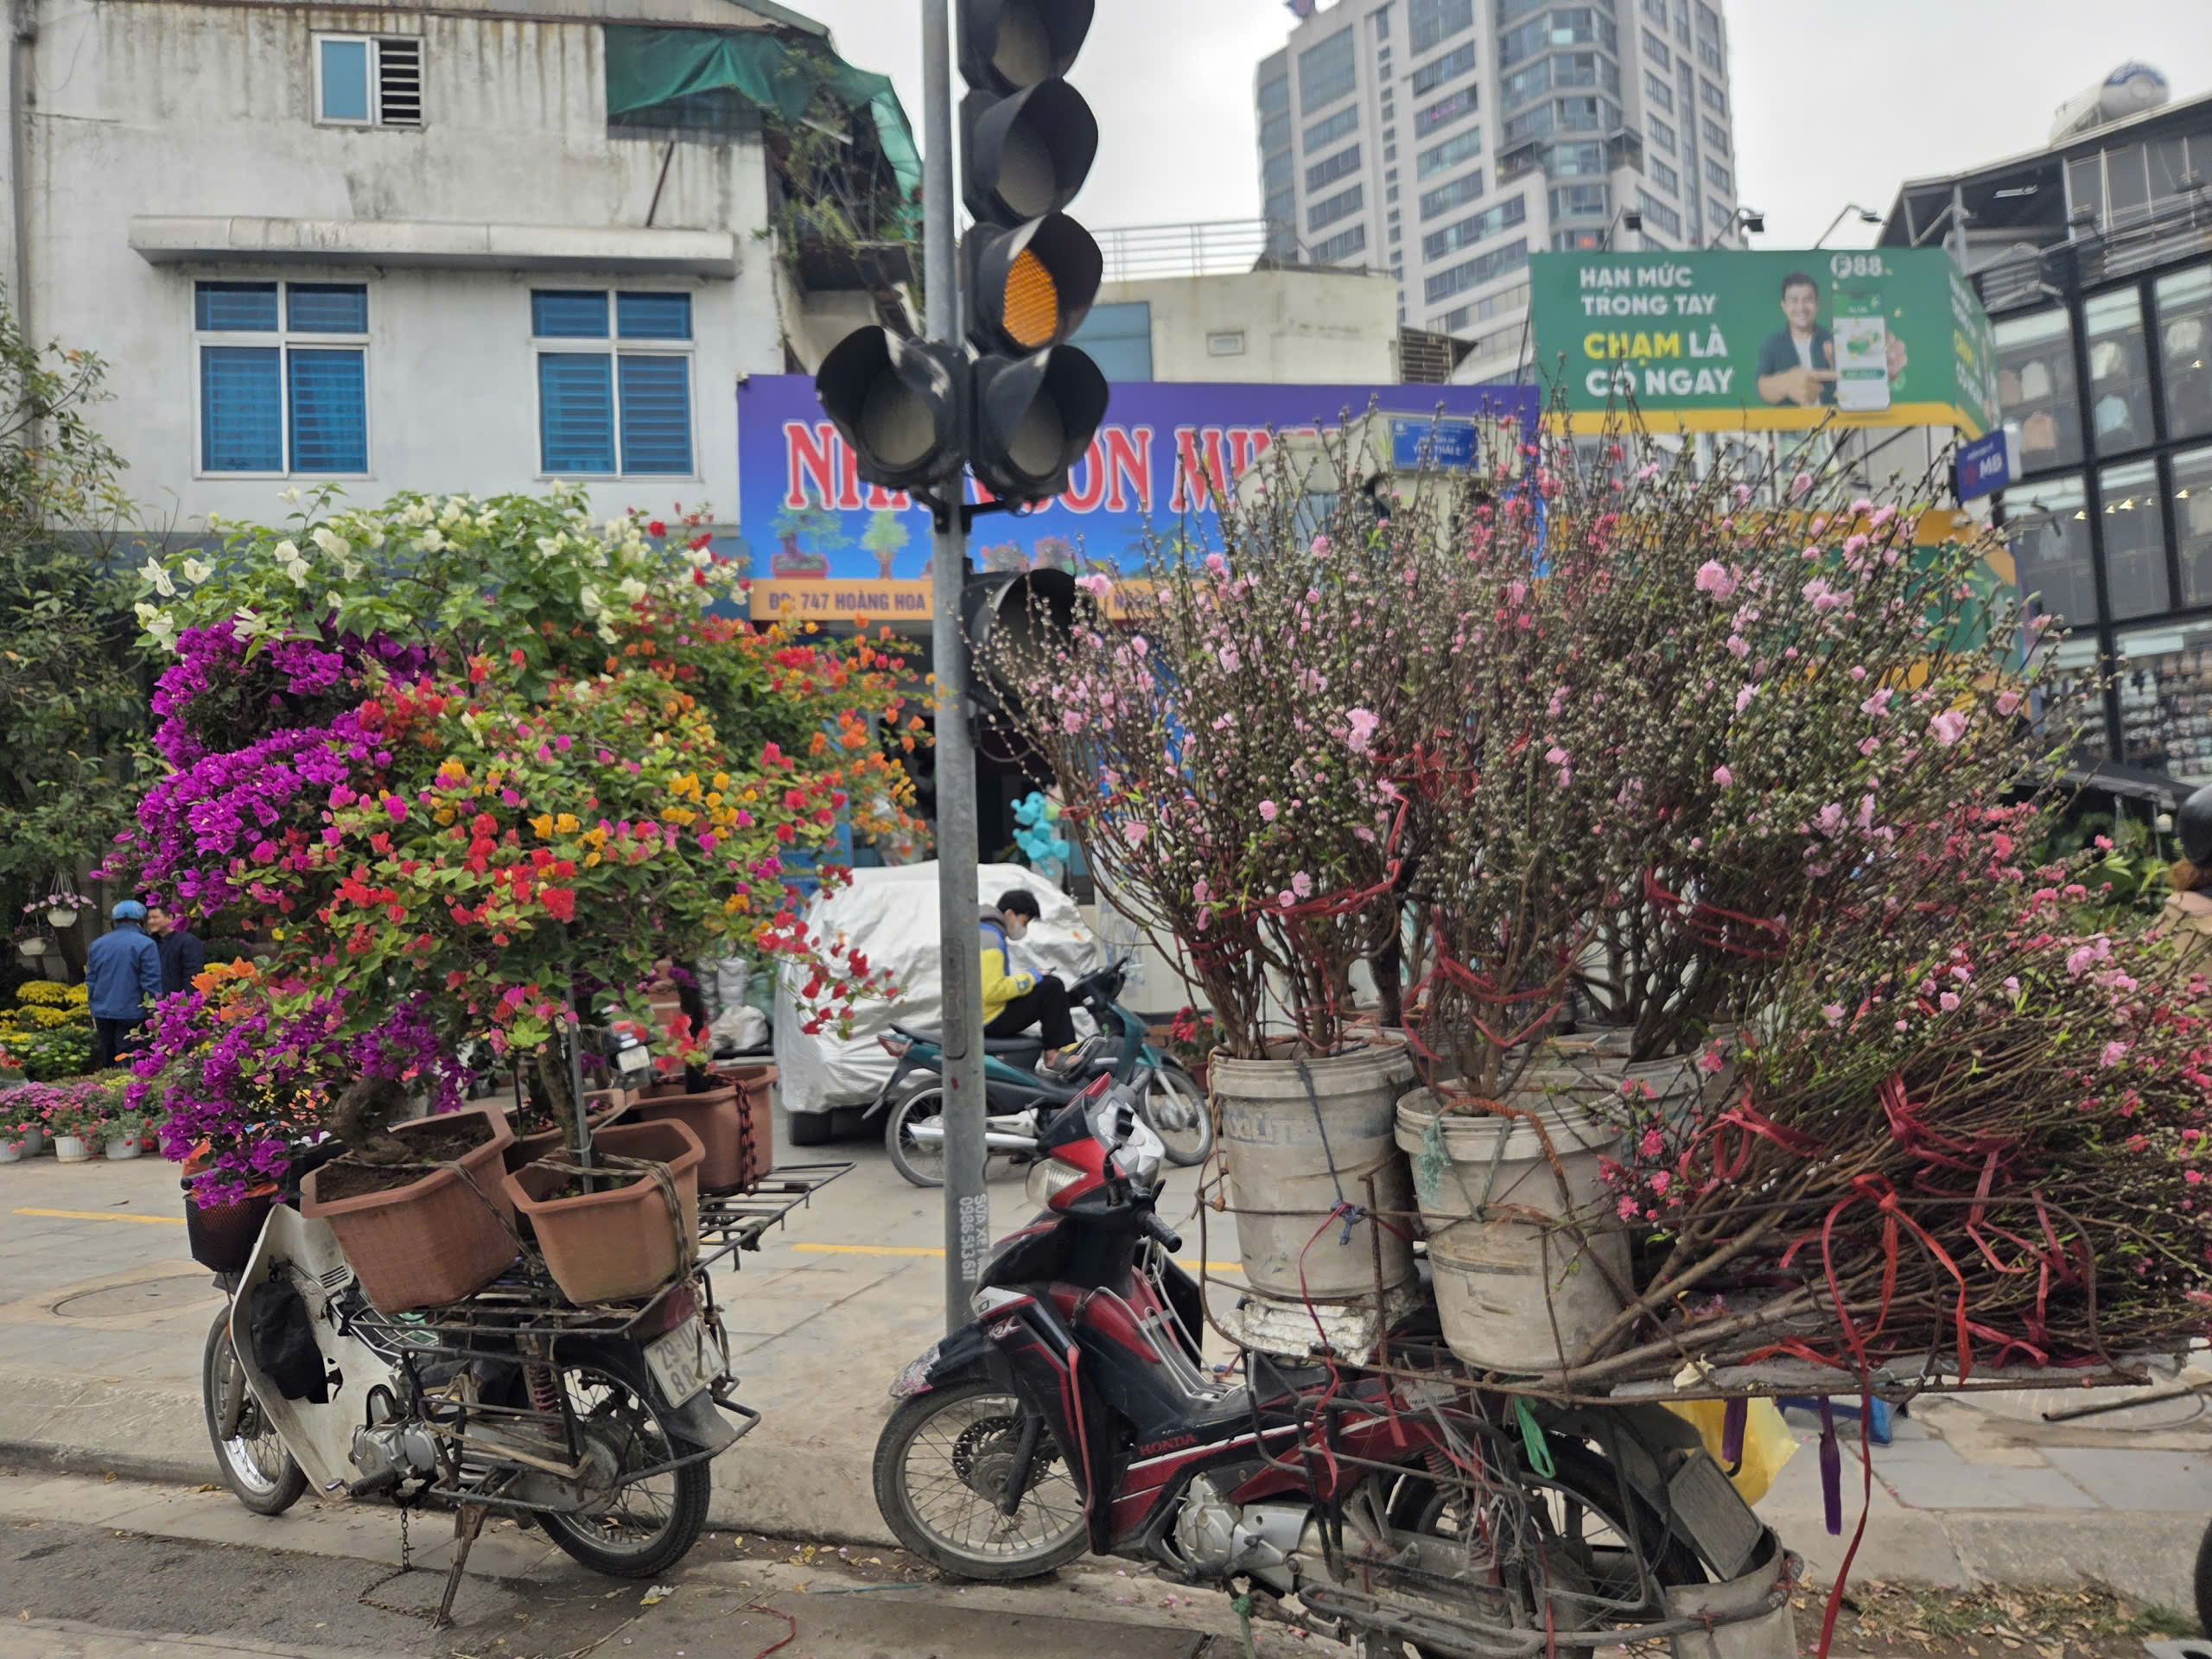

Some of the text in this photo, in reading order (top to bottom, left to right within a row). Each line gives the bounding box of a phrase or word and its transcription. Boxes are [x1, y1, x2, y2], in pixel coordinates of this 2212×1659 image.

[1580, 261, 1694, 294] HẠN MỨC
[1580, 293, 1717, 316] TRONG TAY
[1583, 323, 1728, 366] CHẠM LÀ
[1585, 361, 1734, 397] CÓ NGAY
[1980, 452, 2003, 478] MB
[801, 592, 830, 610] 747
[835, 589, 890, 610] HOÀNG
[894, 592, 926, 610] HOA
[1139, 1434, 1197, 1458] HONDA
